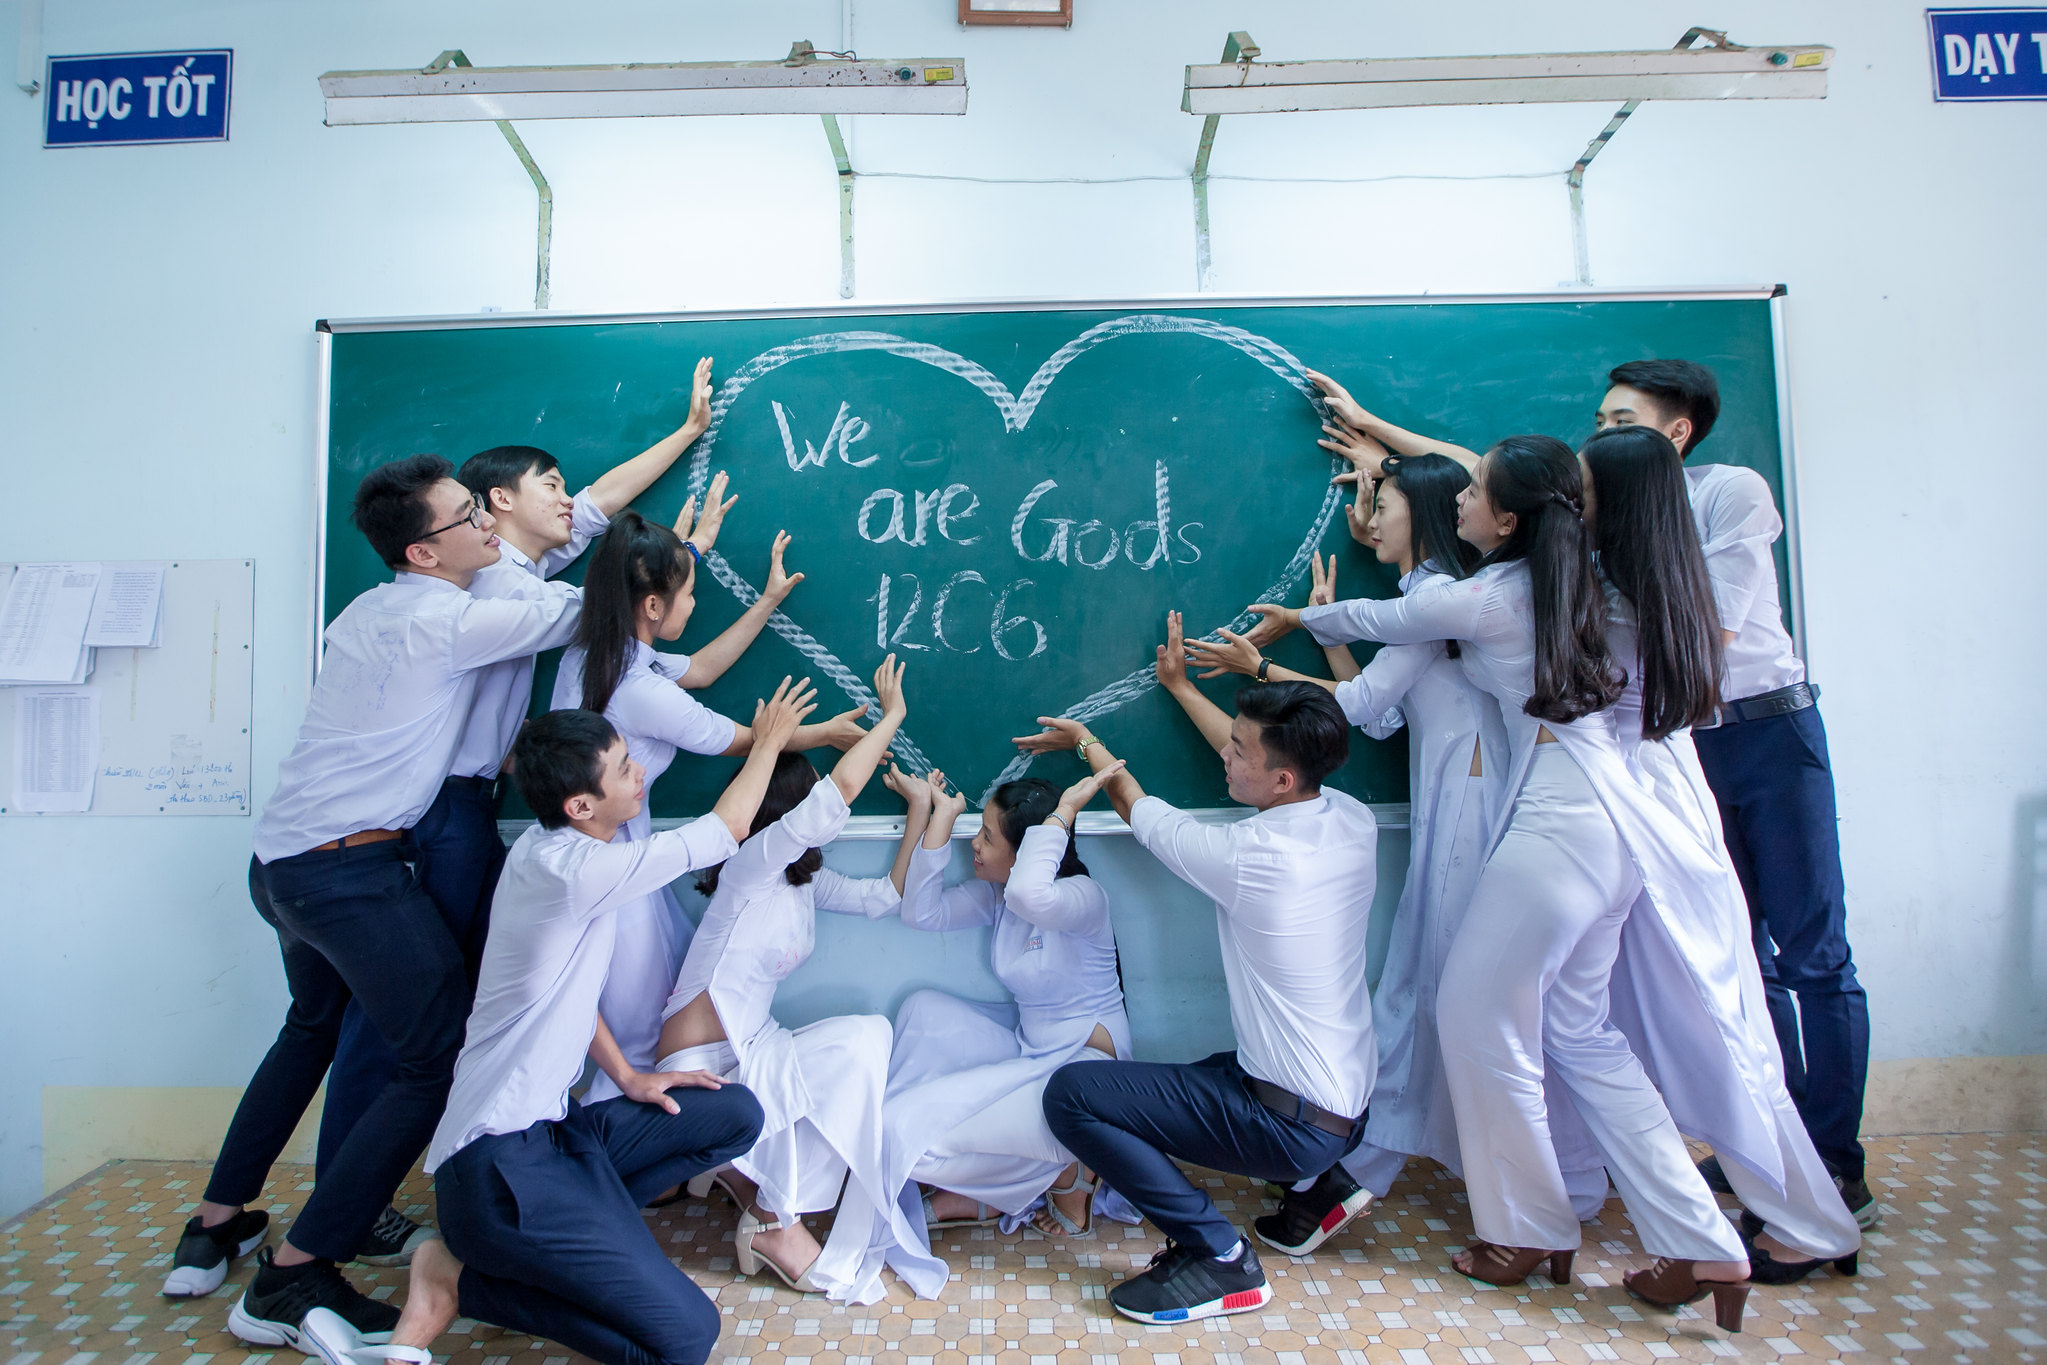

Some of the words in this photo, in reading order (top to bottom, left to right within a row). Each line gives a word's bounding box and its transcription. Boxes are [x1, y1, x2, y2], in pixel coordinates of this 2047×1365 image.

[57, 77, 134, 129] HỌC
[143, 57, 216, 118] TỐT
[1943, 33, 2020, 83] DẠY
[771, 400, 880, 472] We
[858, 483, 983, 547] are
[1011, 458, 1204, 571] Gods
[866, 570, 1048, 662] 12C6
